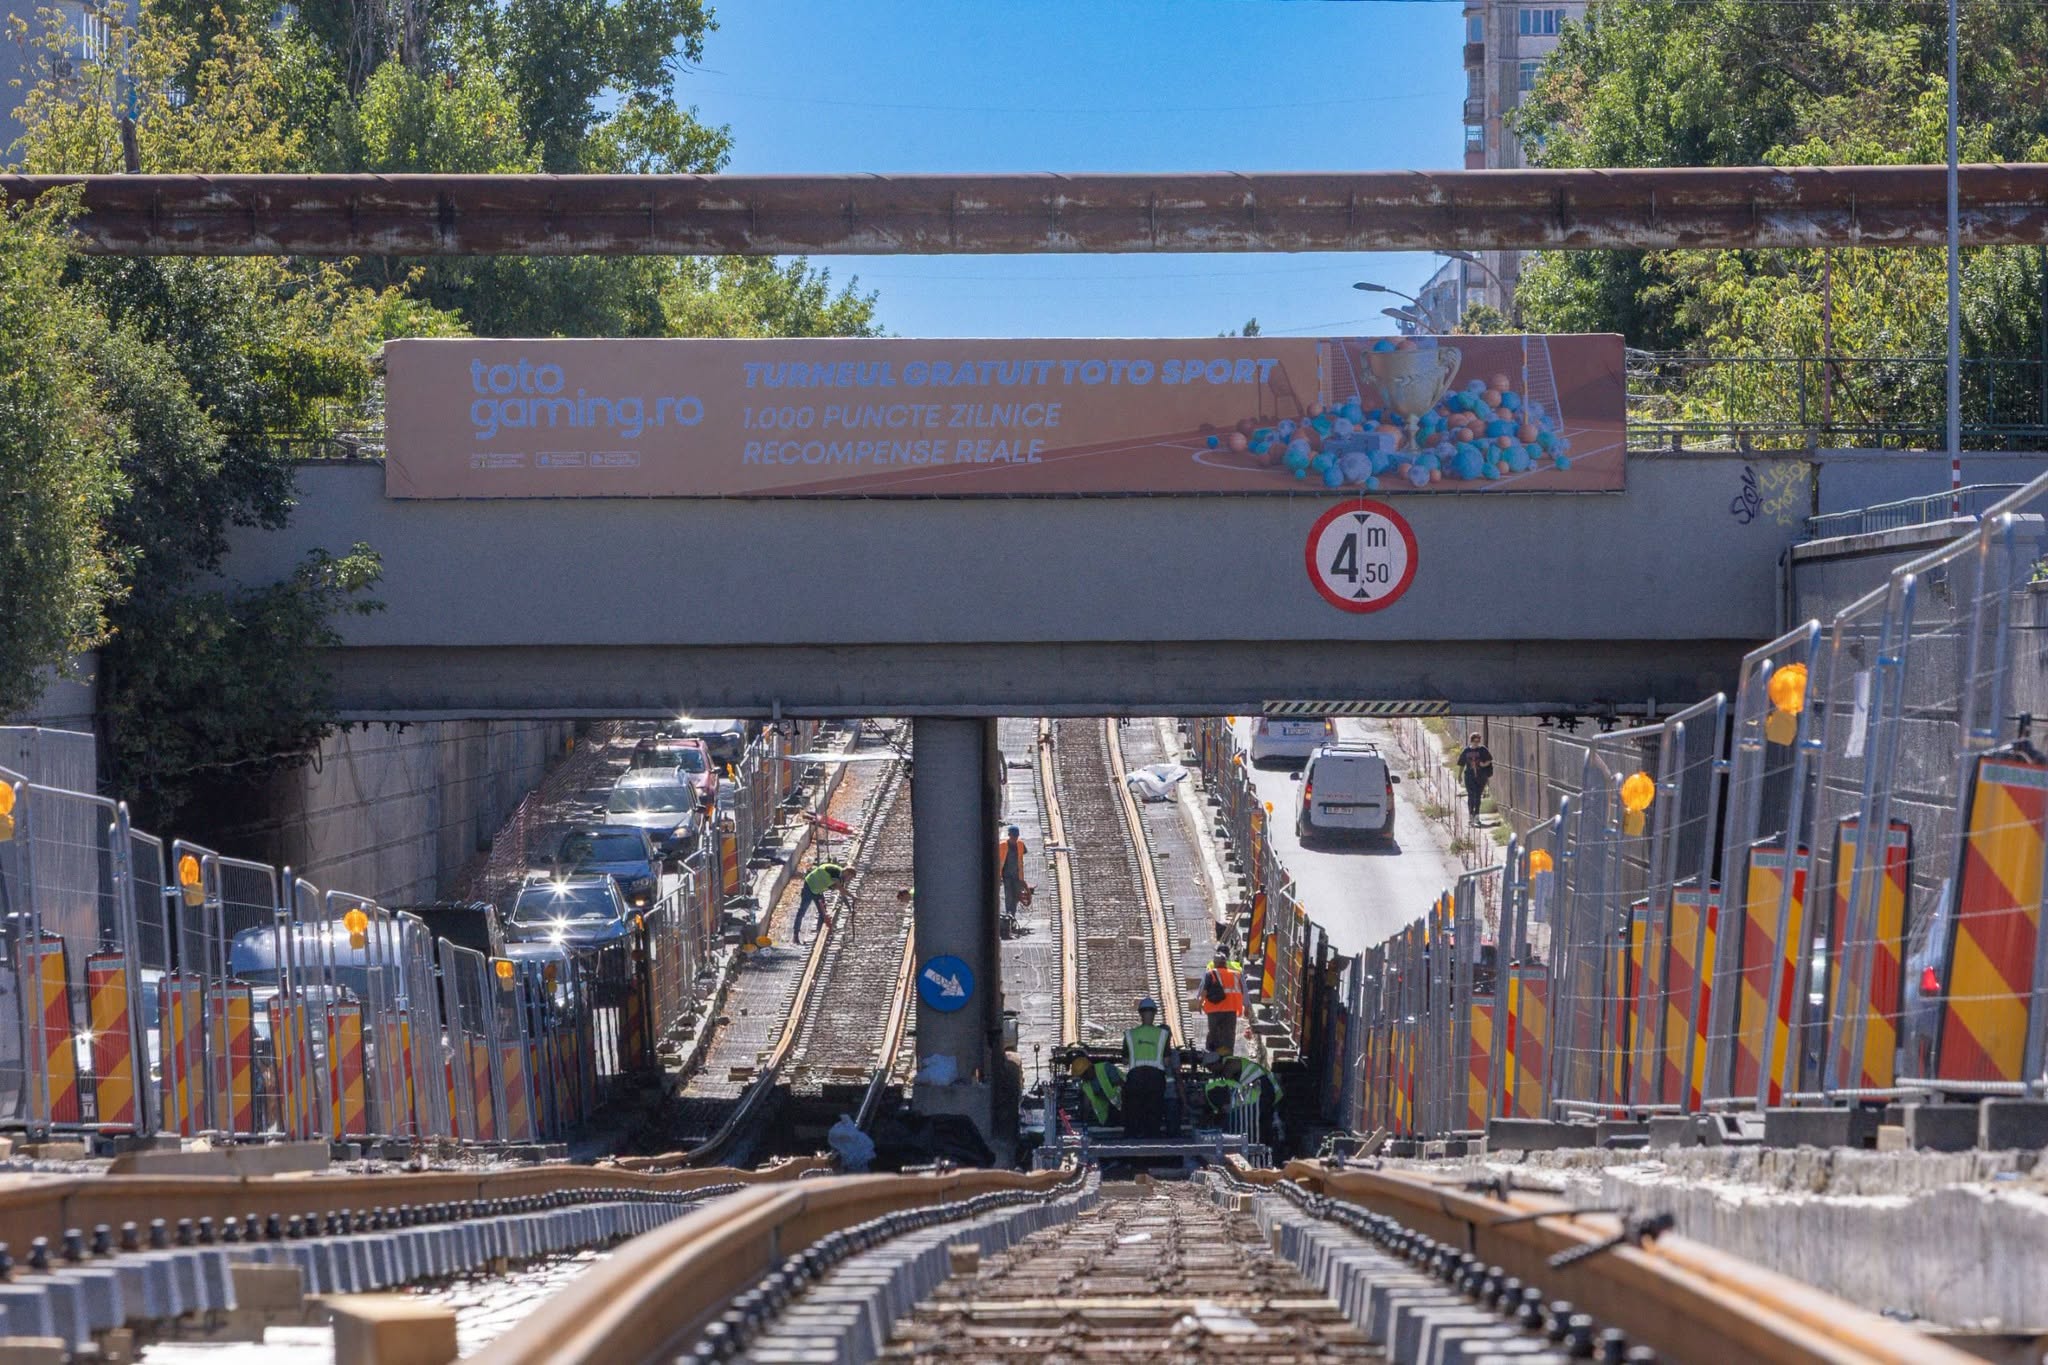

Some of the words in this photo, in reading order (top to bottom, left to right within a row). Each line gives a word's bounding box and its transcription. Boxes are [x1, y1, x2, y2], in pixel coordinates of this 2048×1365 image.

[470, 358, 565, 393] toto
[743, 361, 898, 388] TURNEUL
[903, 360, 1056, 386] GRATUIT
[1060, 359, 1155, 385] TOTO
[1160, 358, 1279, 385] SPORT
[470, 388, 704, 441] gaming.ro
[743, 405, 815, 430] 1.000
[822, 404, 943, 428] PUNCTE
[947, 402, 1062, 428] ZILNICE
[743, 440, 948, 465] RECOMPENSE
[953, 438, 1046, 463] REALE
[1367, 527, 1387, 547] m
